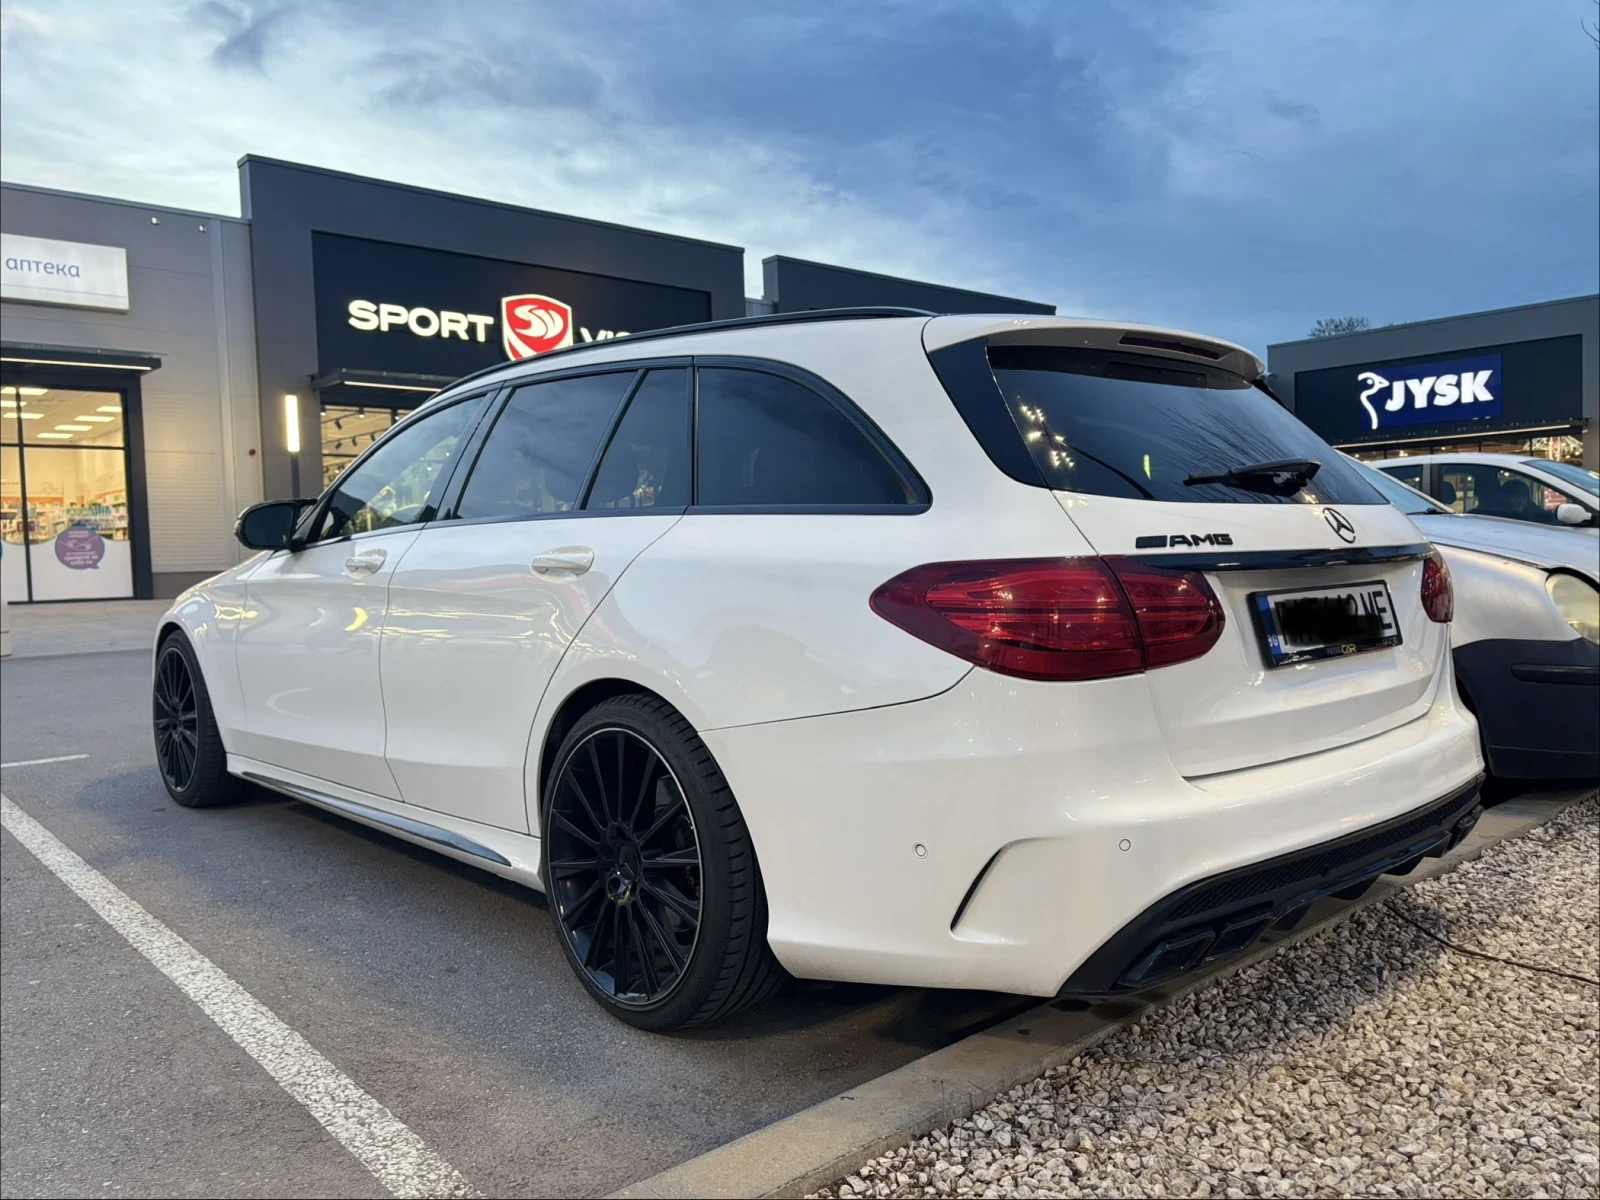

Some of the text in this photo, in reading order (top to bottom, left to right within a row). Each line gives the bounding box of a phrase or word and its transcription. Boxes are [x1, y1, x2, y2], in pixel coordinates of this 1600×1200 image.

[5, 257, 81, 278] аптека
[348, 299, 495, 343] SPORT
[1384, 369, 1495, 412] JYSK
[1169, 533, 1234, 548] AMG
